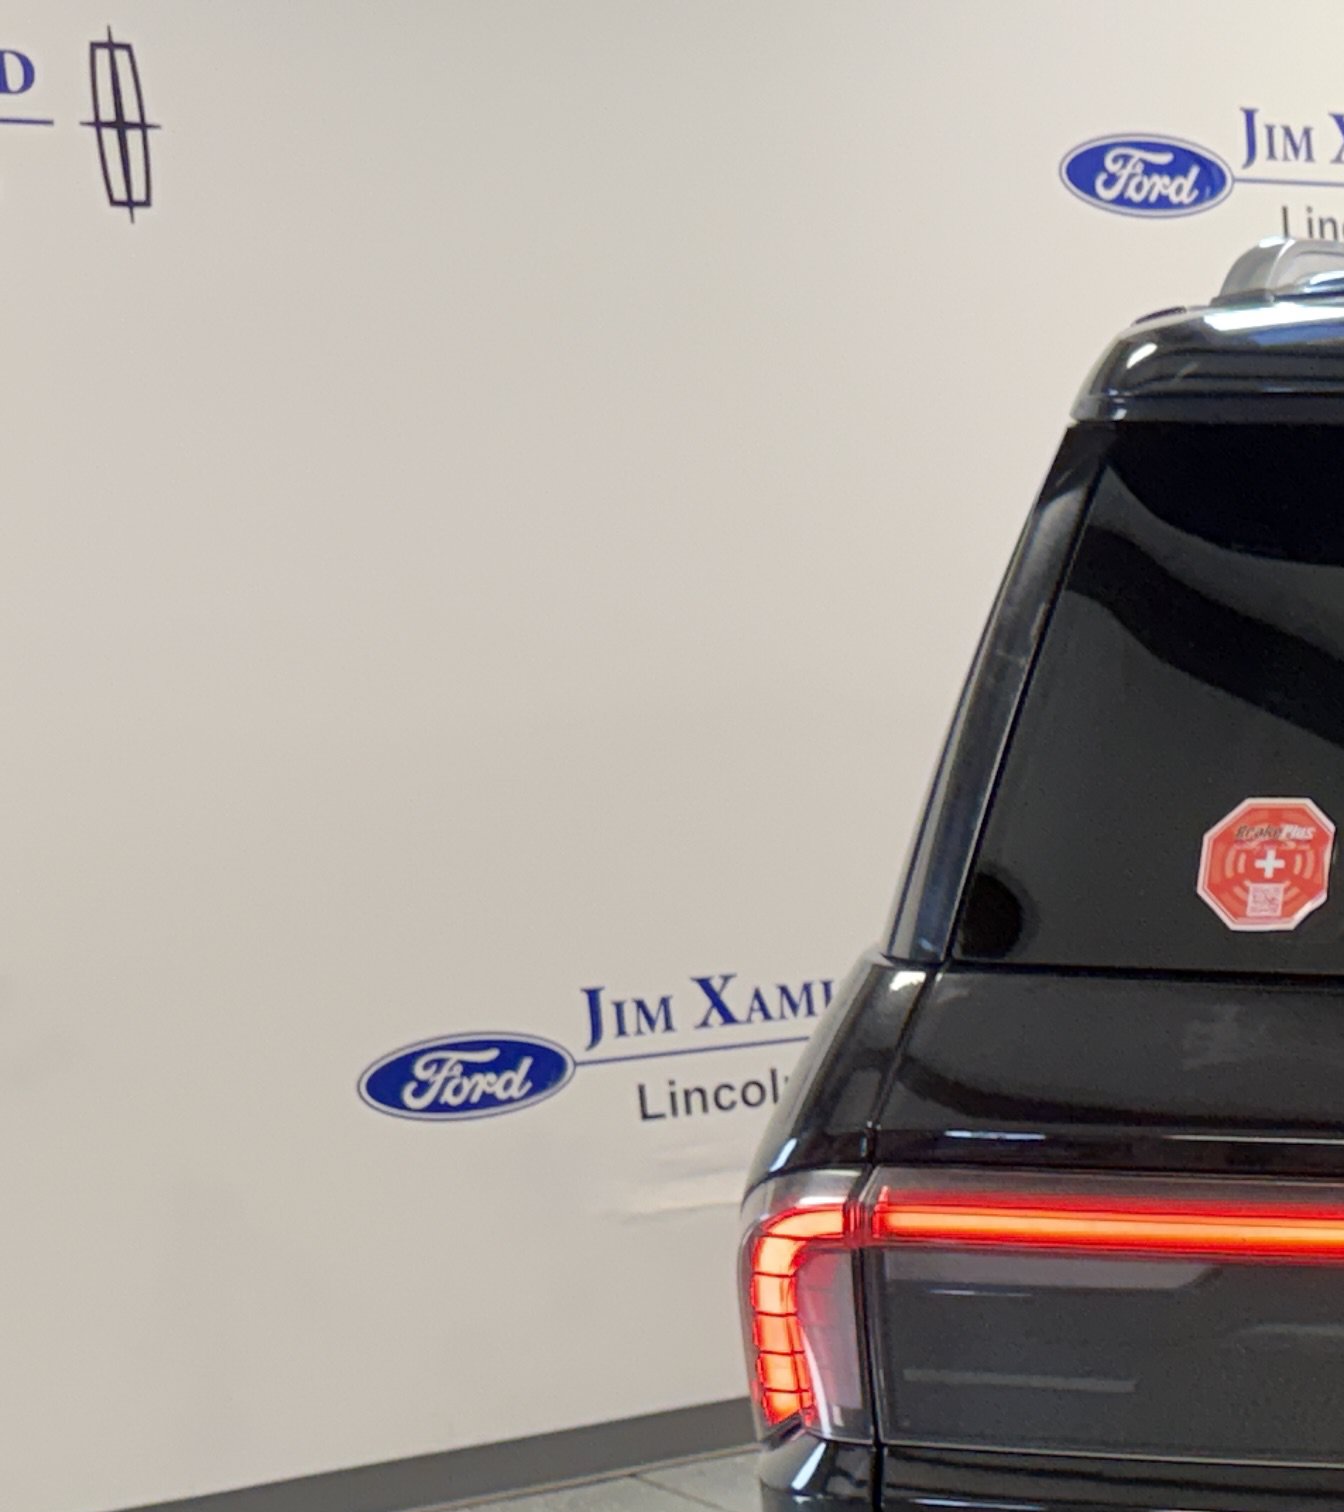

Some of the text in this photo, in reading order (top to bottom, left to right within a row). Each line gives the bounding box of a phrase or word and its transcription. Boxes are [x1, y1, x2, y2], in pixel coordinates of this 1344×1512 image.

[1240, 107, 1313, 169] JIM
[1094, 147, 1198, 205] Ford
[580, 973, 835, 1051] JIM XAMI
[402, 1048, 533, 1110] Ford
[637, 1067, 789, 1121] Lincol
